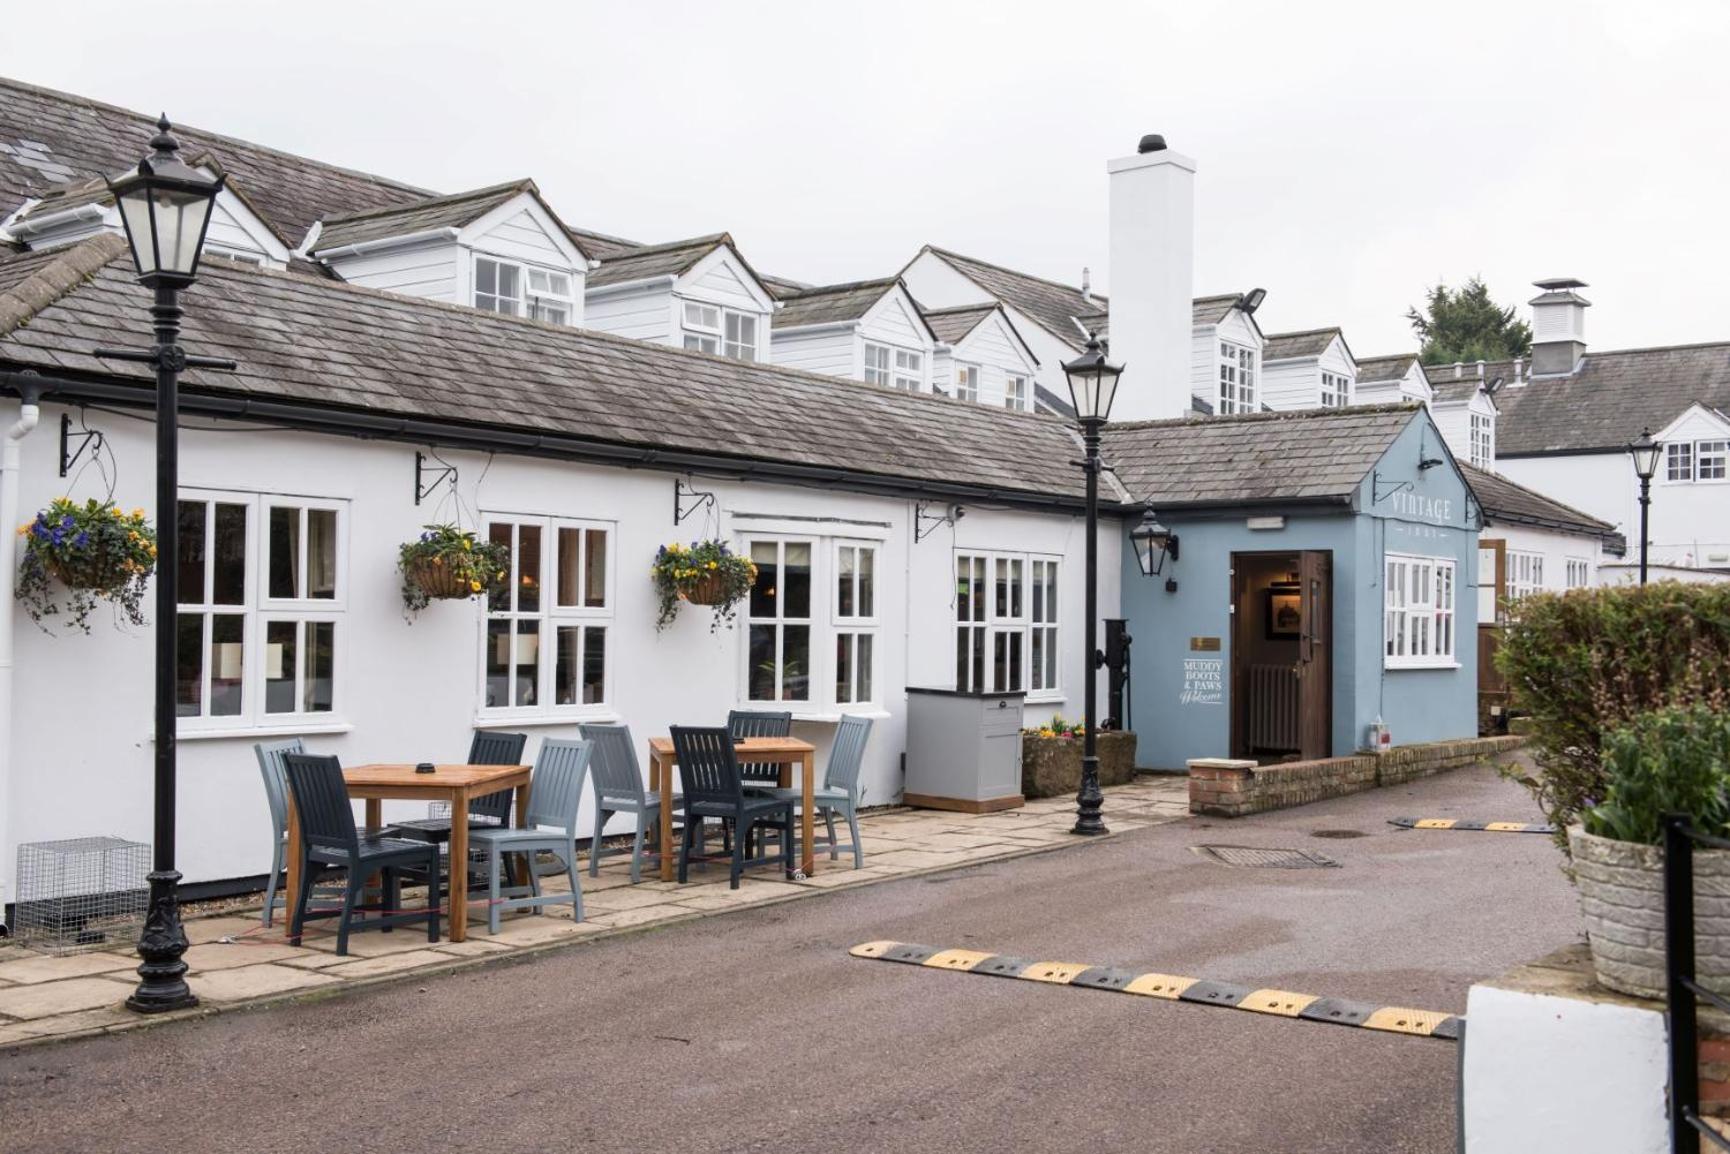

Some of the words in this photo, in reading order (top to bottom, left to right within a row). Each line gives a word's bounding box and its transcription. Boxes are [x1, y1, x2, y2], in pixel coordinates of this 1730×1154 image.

[1183, 662, 1223, 671] MUDDY
[1185, 671, 1221, 681] BOOTS
[1184, 681, 1191, 690] &
[1194, 681, 1222, 690] PAWS
